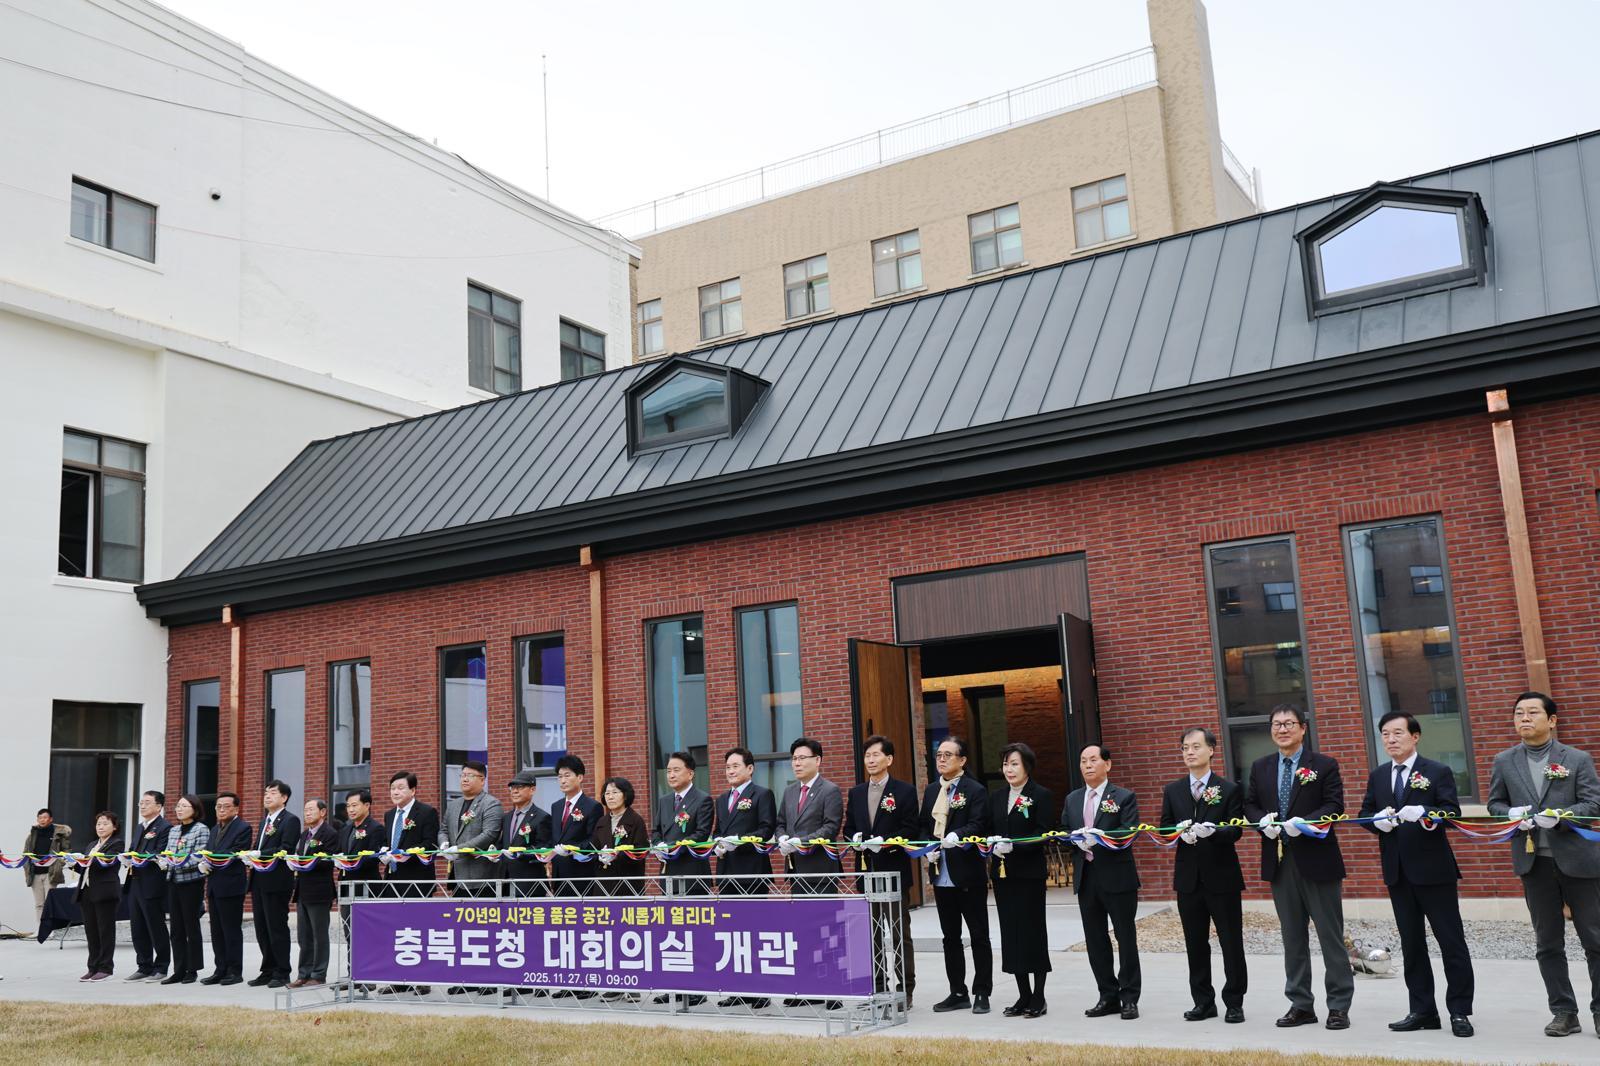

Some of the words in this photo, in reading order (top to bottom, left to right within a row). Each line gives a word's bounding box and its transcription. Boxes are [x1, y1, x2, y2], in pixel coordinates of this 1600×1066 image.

[455, 907, 500, 925] 70년의
[505, 906, 545, 925] 시간을
[550, 906, 578, 925] 품은
[582, 906, 615, 926] 공간,
[621, 906, 665, 926] 새롭게
[671, 906, 716, 926] 열리다
[393, 927, 527, 970] 충북도청
[543, 929, 695, 973] 대회의실
[714, 931, 798, 976] 개관
[523, 972, 551, 984] 2025.
[606, 974, 639, 986] 09:00
